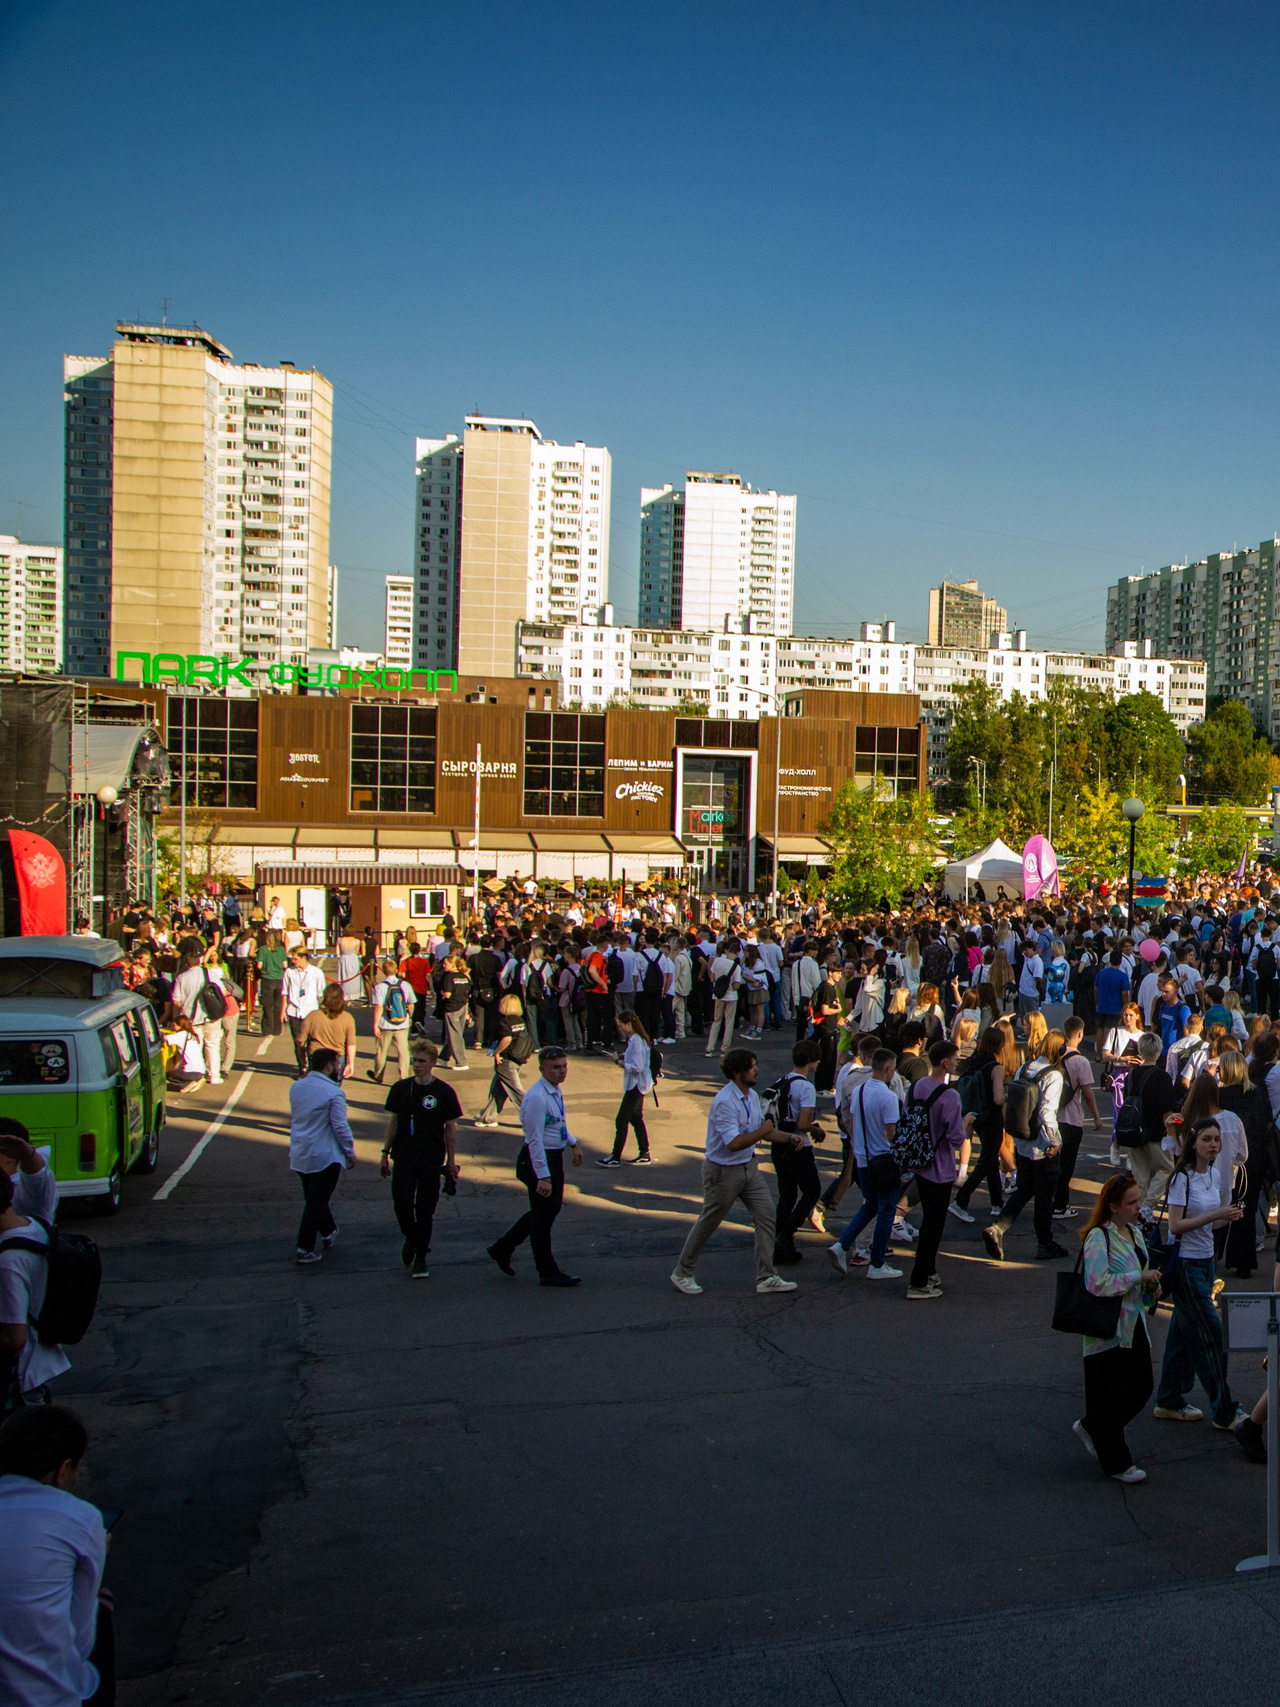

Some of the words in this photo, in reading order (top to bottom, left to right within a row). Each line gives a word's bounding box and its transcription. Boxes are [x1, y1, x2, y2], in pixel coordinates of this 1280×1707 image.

[442, 761, 517, 774] СЫРОВАРНЯ
[608, 759, 638, 767] ЛЕПИМ
[648, 760, 674, 768] ВАРИМ
[615, 781, 664, 799] Chickiez
